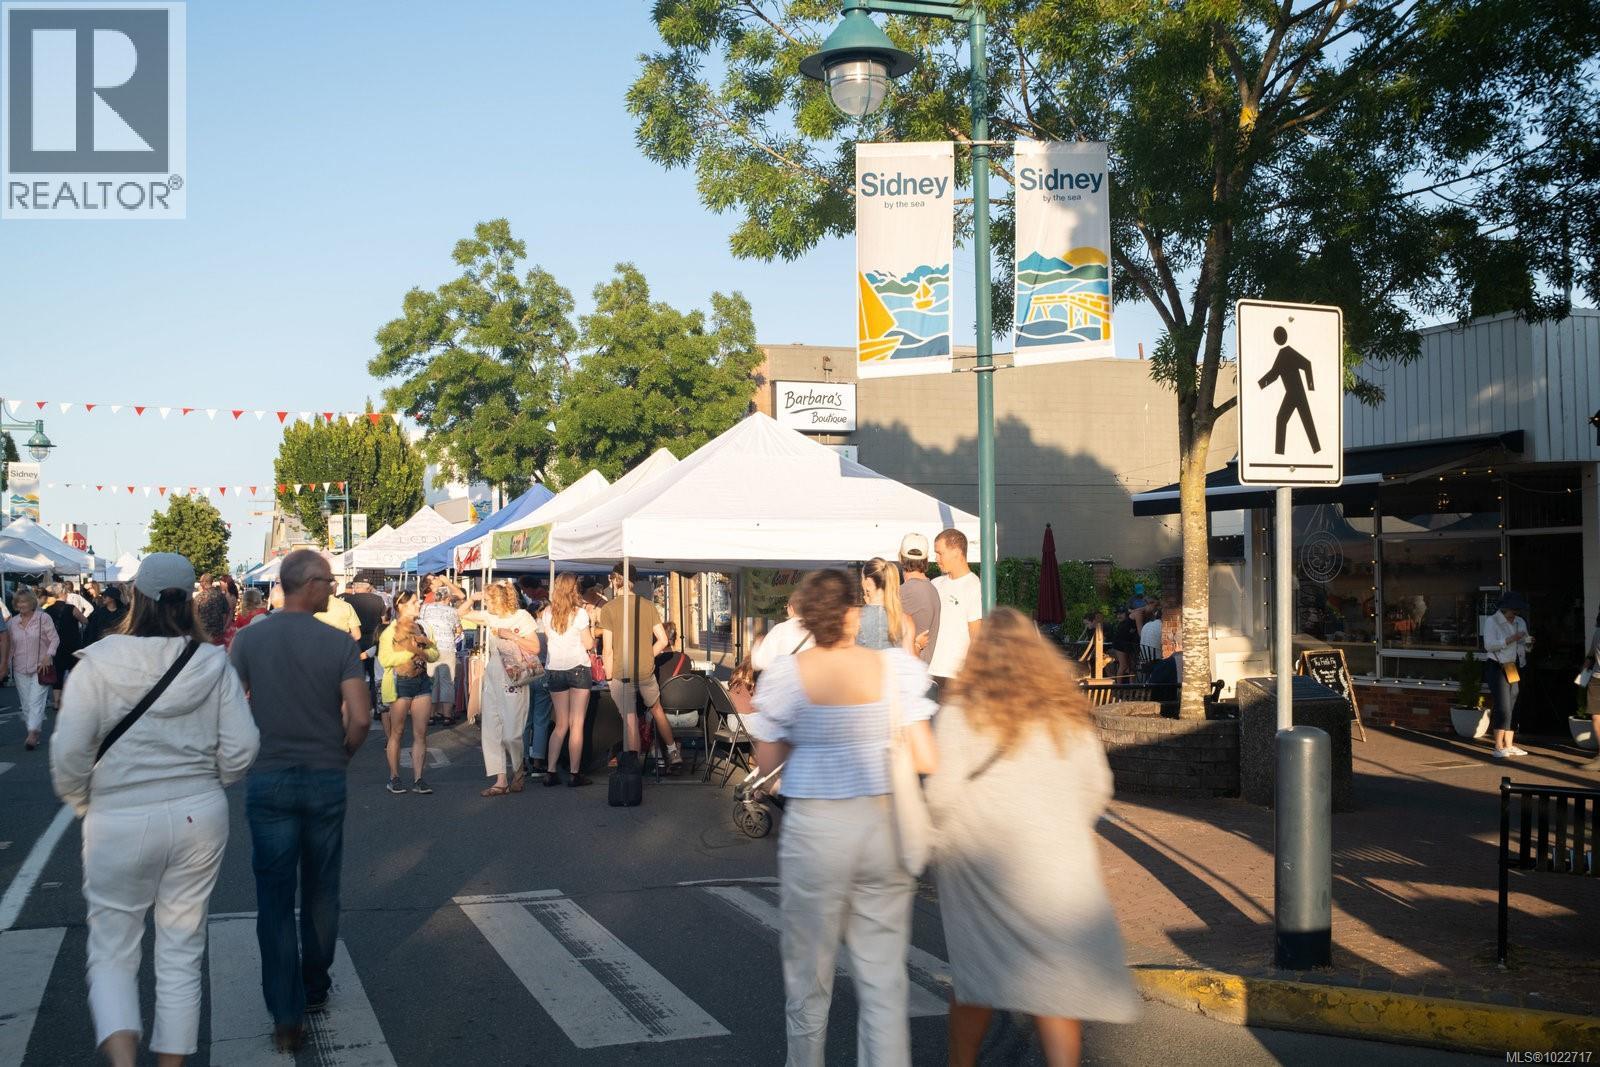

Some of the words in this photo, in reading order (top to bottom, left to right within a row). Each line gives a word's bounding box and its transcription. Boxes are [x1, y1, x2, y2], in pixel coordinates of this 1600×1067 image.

[861, 172, 949, 199] Sidney
[1020, 168, 1103, 194] Sidney
[884, 201, 894, 210] by
[1043, 195, 1052, 203] by
[785, 389, 842, 409] Barbara's
[811, 411, 848, 425] Boutique
[10, 469, 38, 479] Sidney
